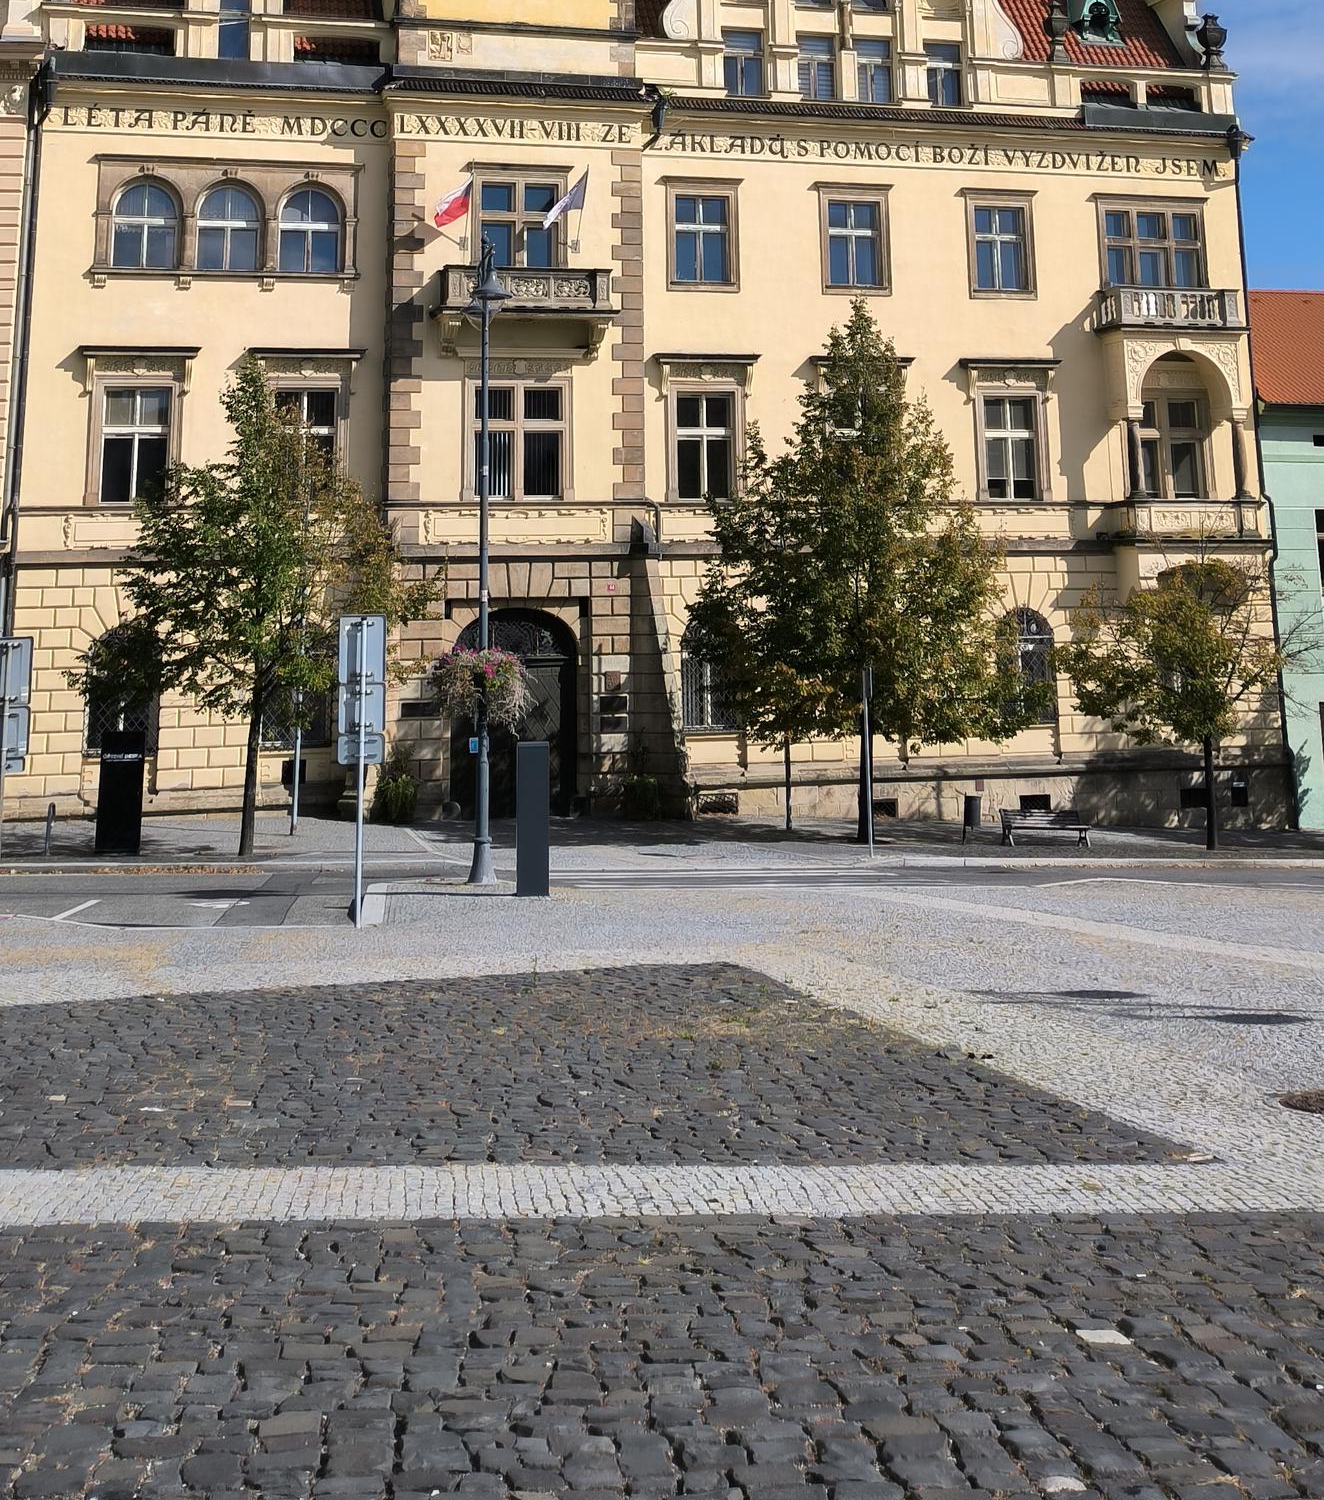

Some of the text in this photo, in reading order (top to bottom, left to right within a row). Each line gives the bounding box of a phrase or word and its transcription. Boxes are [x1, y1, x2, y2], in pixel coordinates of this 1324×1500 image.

[62, 102, 154, 130] LÉTA
[172, 108, 256, 134] PÁNĚ
[599, 123, 631, 144] ZE
[796, 138, 809, 157] S
[819, 140, 922, 163] POMOCÍ
[932, 143, 990, 166] BOŽÍ
[1003, 149, 1141, 173] VYZDVIŽEN
